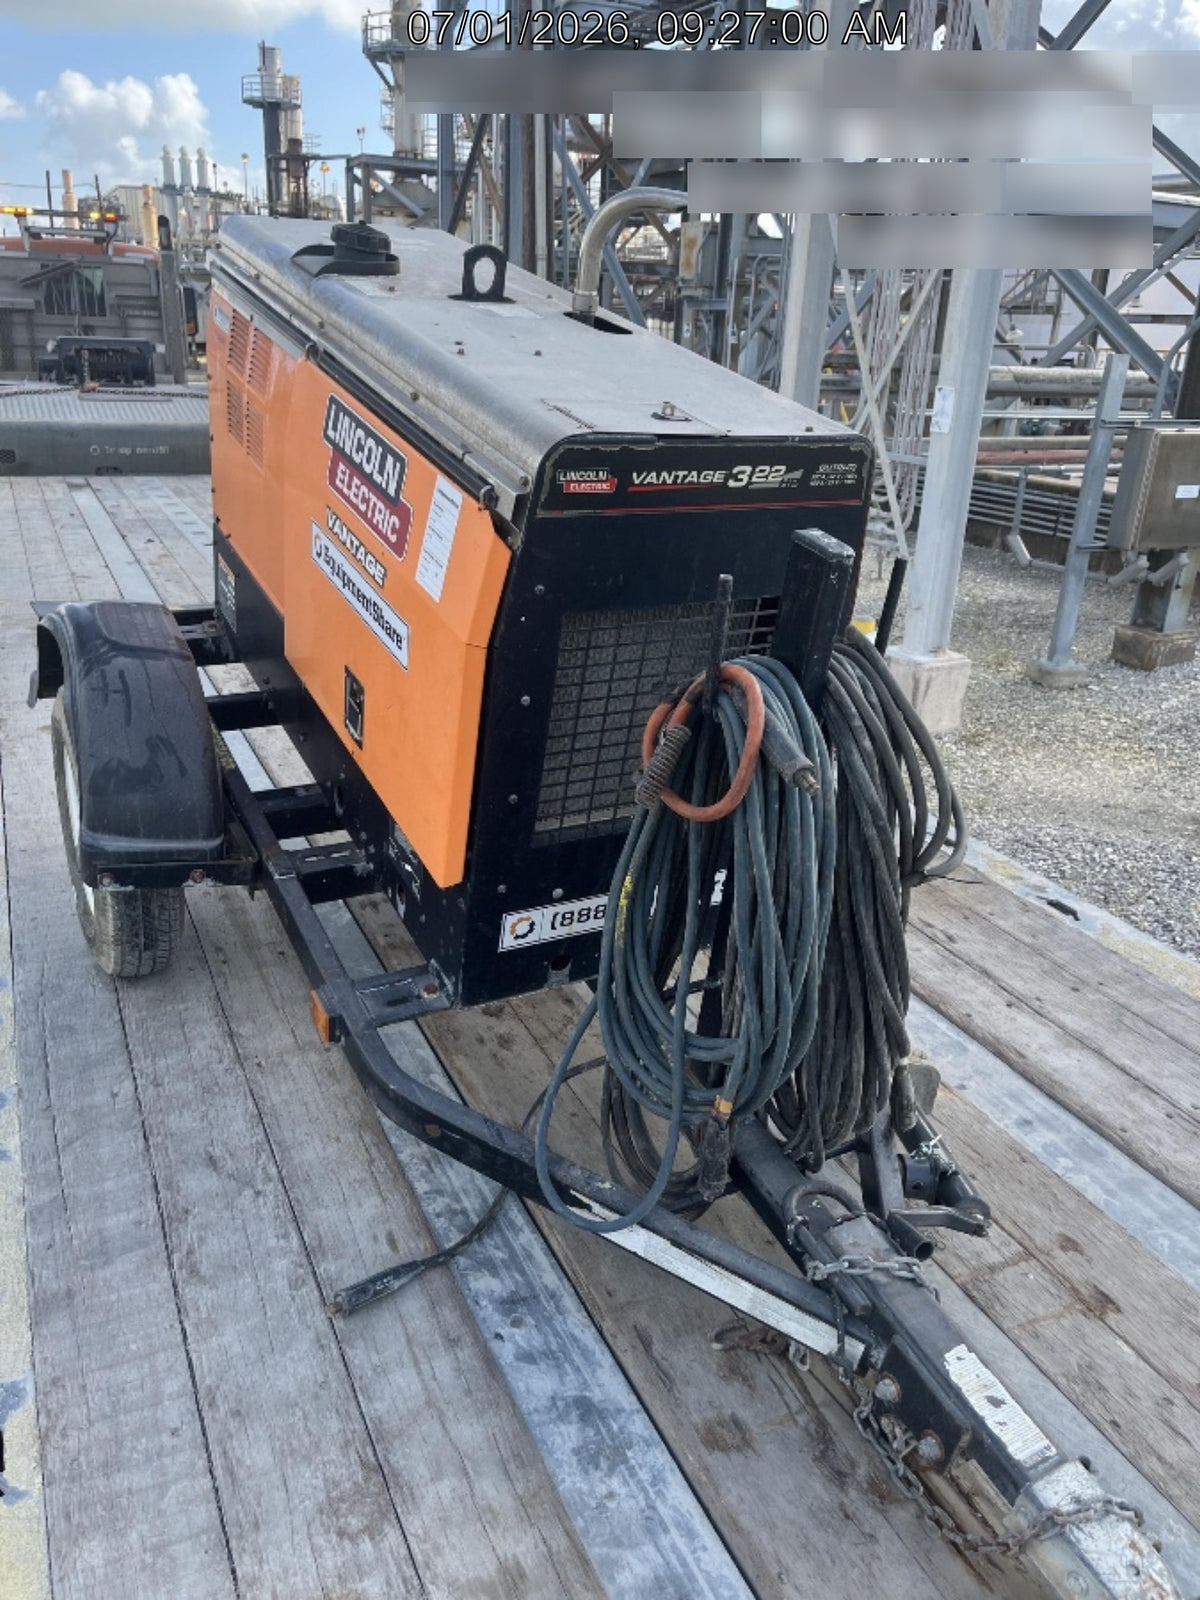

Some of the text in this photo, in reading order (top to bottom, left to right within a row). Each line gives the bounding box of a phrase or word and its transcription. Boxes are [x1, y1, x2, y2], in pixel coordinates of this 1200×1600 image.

[326, 403, 401, 498] LINCOLN
[559, 469, 608, 481] LINCOLN
[569, 482, 611, 491] ELECTRIC
[632, 470, 727, 484] VANTAGE
[727, 465, 787, 488] 322
[335, 461, 400, 544] ELECTRIC
[326, 505, 387, 588] VANTAGE
[321, 542, 403, 650] EquipmentShare
